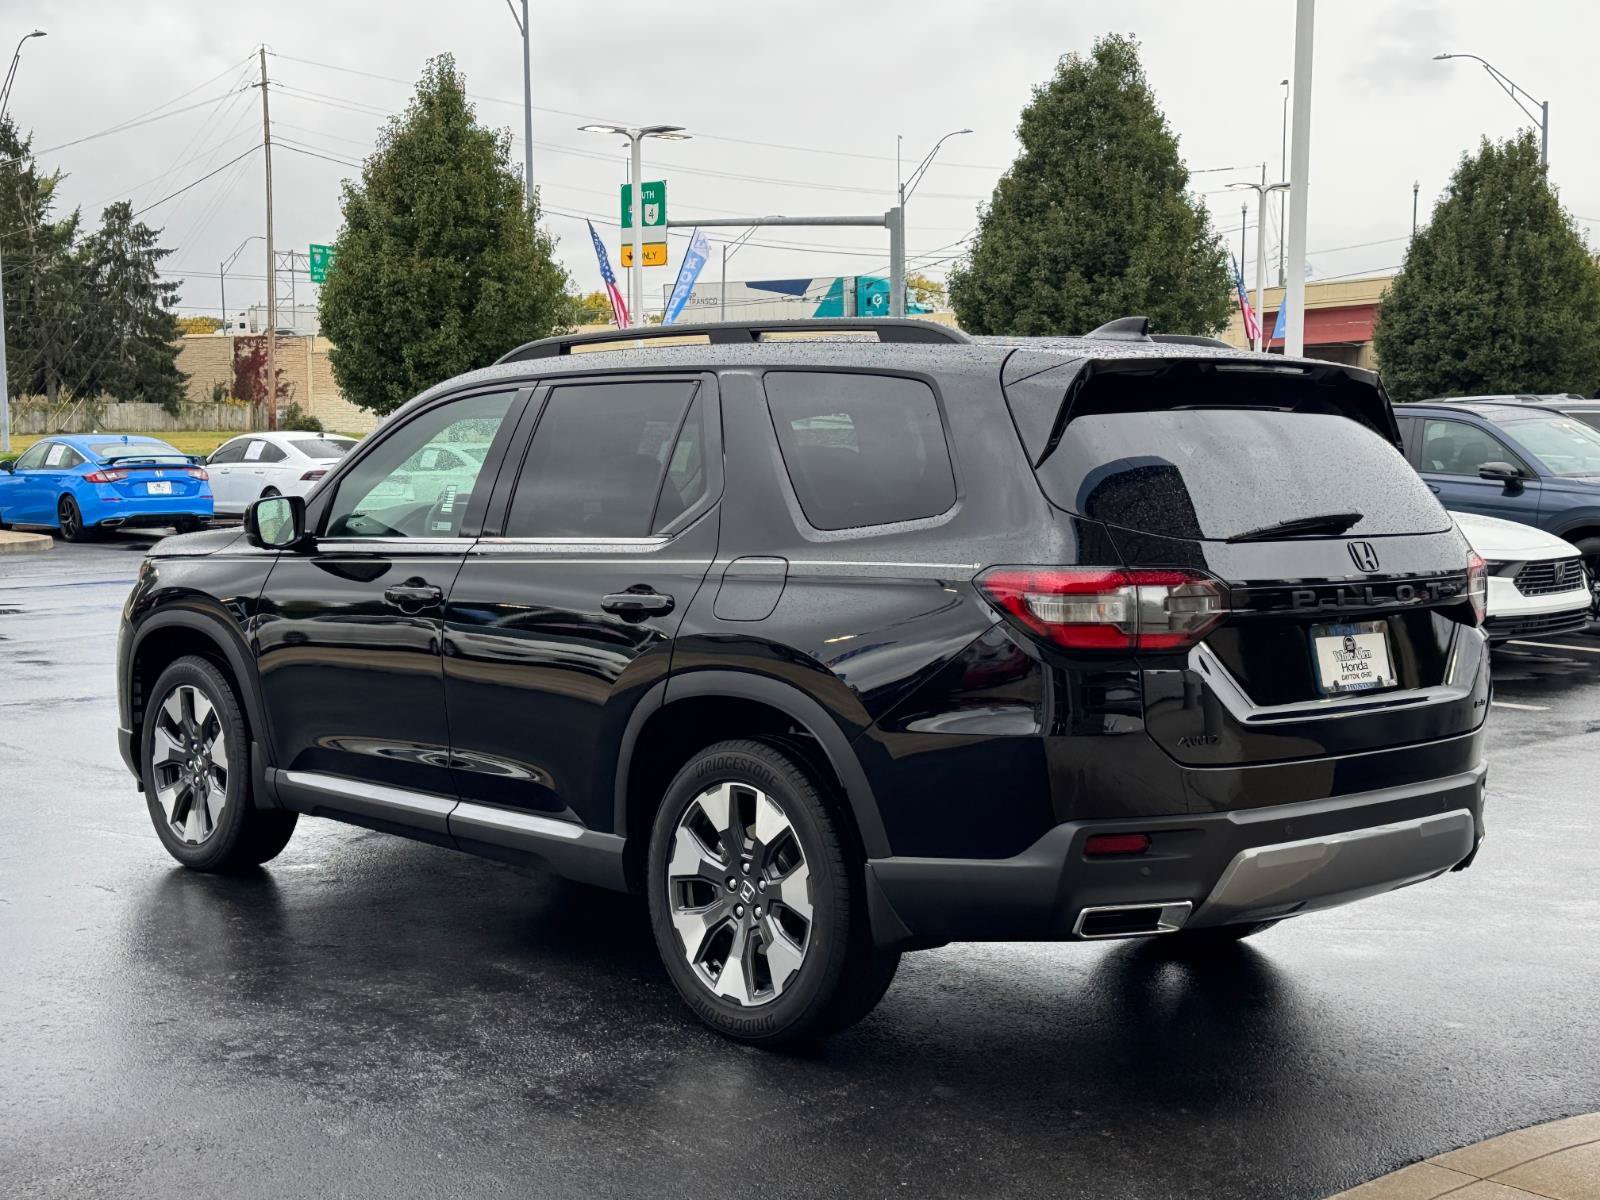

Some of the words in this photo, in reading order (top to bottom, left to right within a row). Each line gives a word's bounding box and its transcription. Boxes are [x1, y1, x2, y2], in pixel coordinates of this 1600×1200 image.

[641, 190, 655, 199] UTH
[648, 208, 654, 219] 4
[642, 252, 657, 260] NLY
[1291, 582, 1441, 609] PILOT
[1341, 661, 1368, 672] Honda
[696, 756, 777, 786] BRIDGESTONE
[691, 994, 776, 1032] BRIDGESTONE
